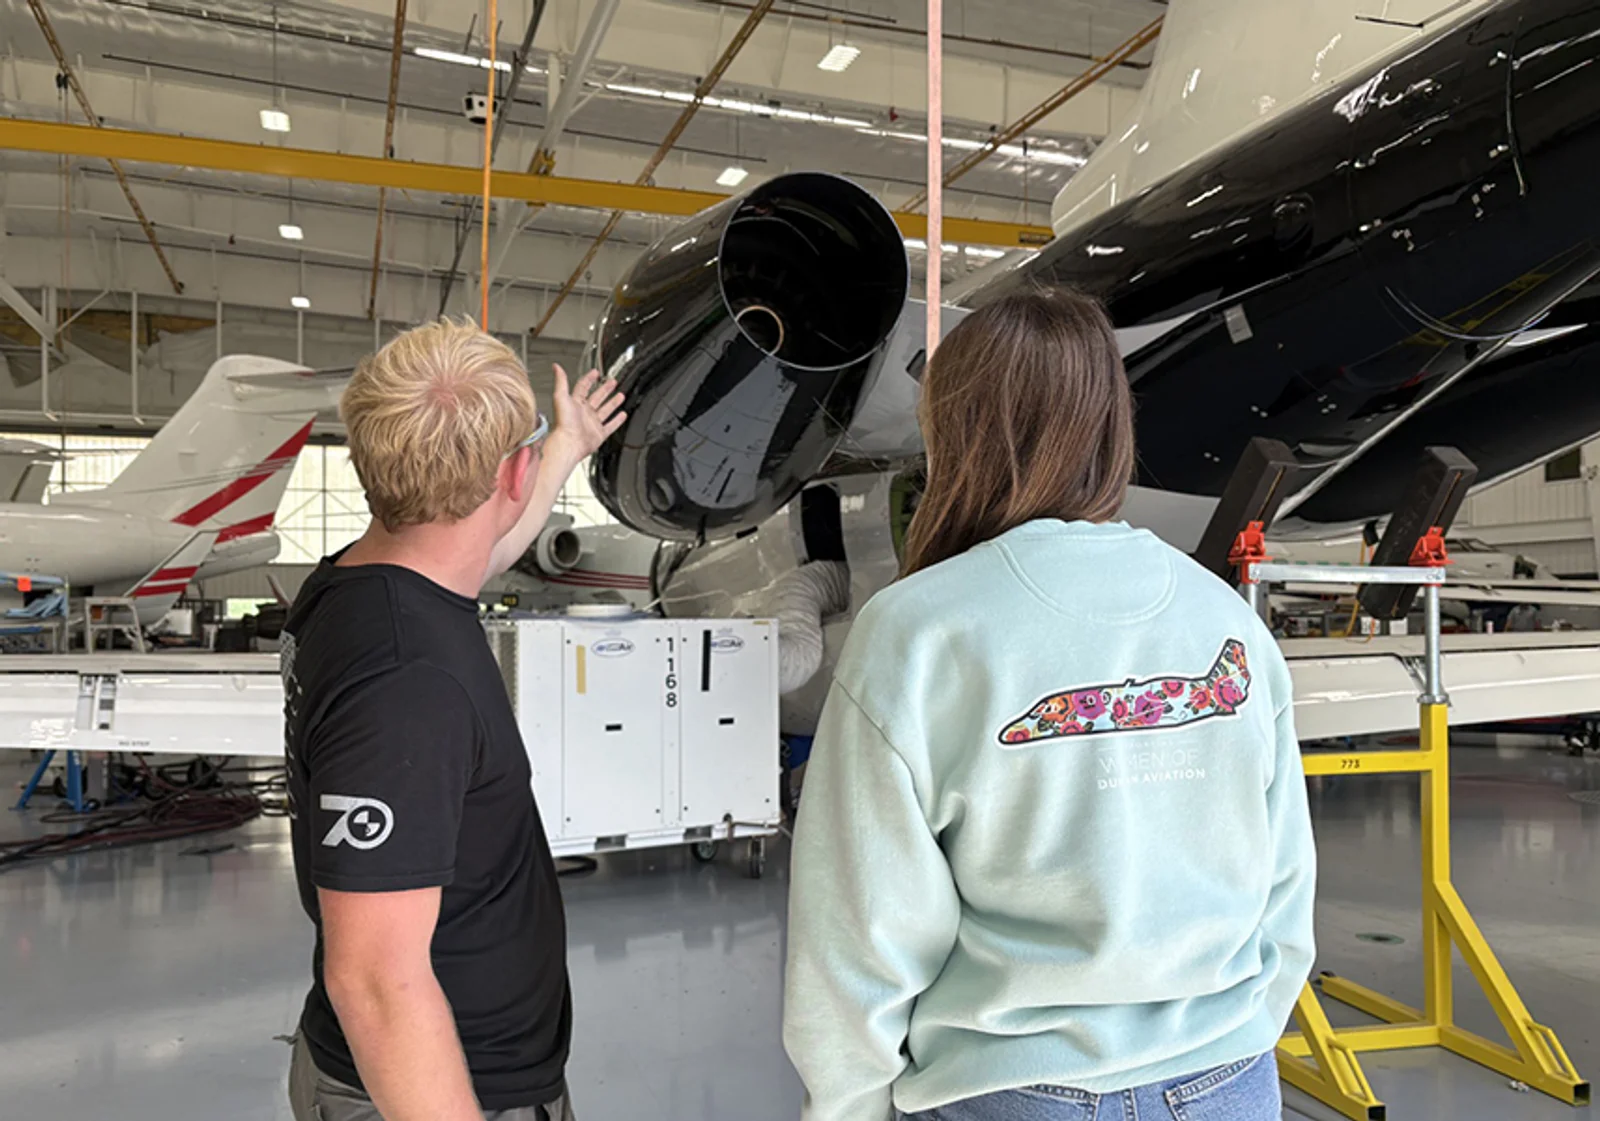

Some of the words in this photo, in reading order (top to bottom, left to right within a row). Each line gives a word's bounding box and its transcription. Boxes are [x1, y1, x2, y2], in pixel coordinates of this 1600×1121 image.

[666, 637, 677, 707] 1168
[1098, 751, 1164, 773] WMEN
[1171, 748, 1199, 767] OF
[1143, 767, 1206, 783] AVIATION
